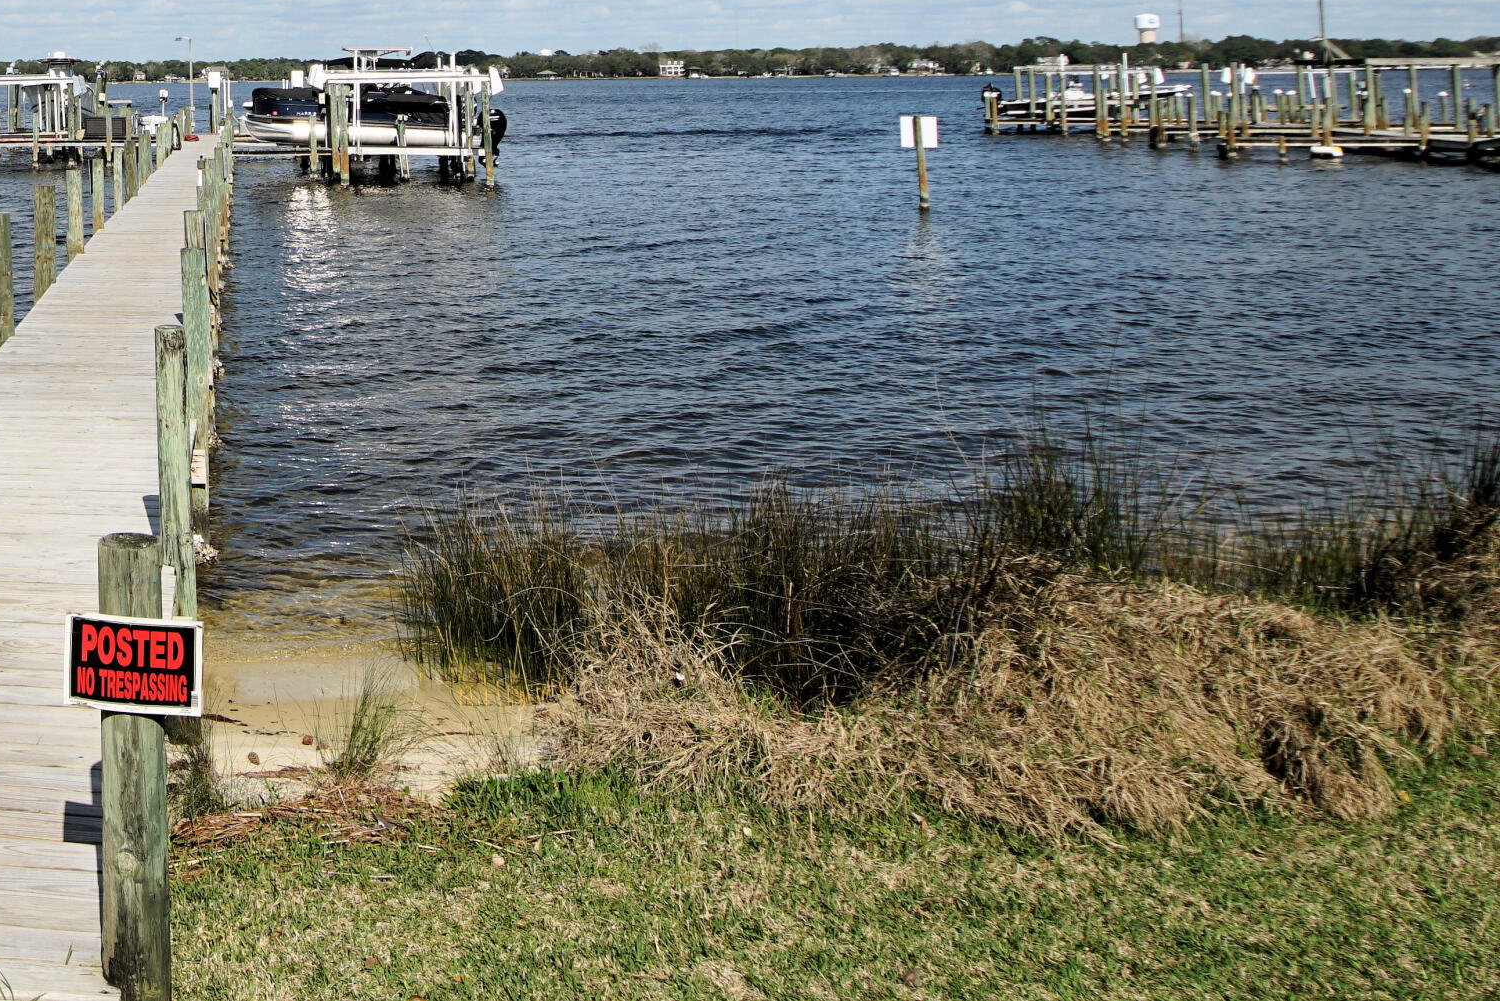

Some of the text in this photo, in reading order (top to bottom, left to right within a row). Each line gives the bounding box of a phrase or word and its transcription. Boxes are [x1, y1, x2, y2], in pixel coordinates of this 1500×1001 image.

[81, 623, 185, 669] POSTED
[77, 666, 188, 703] NO TRESPASSING
